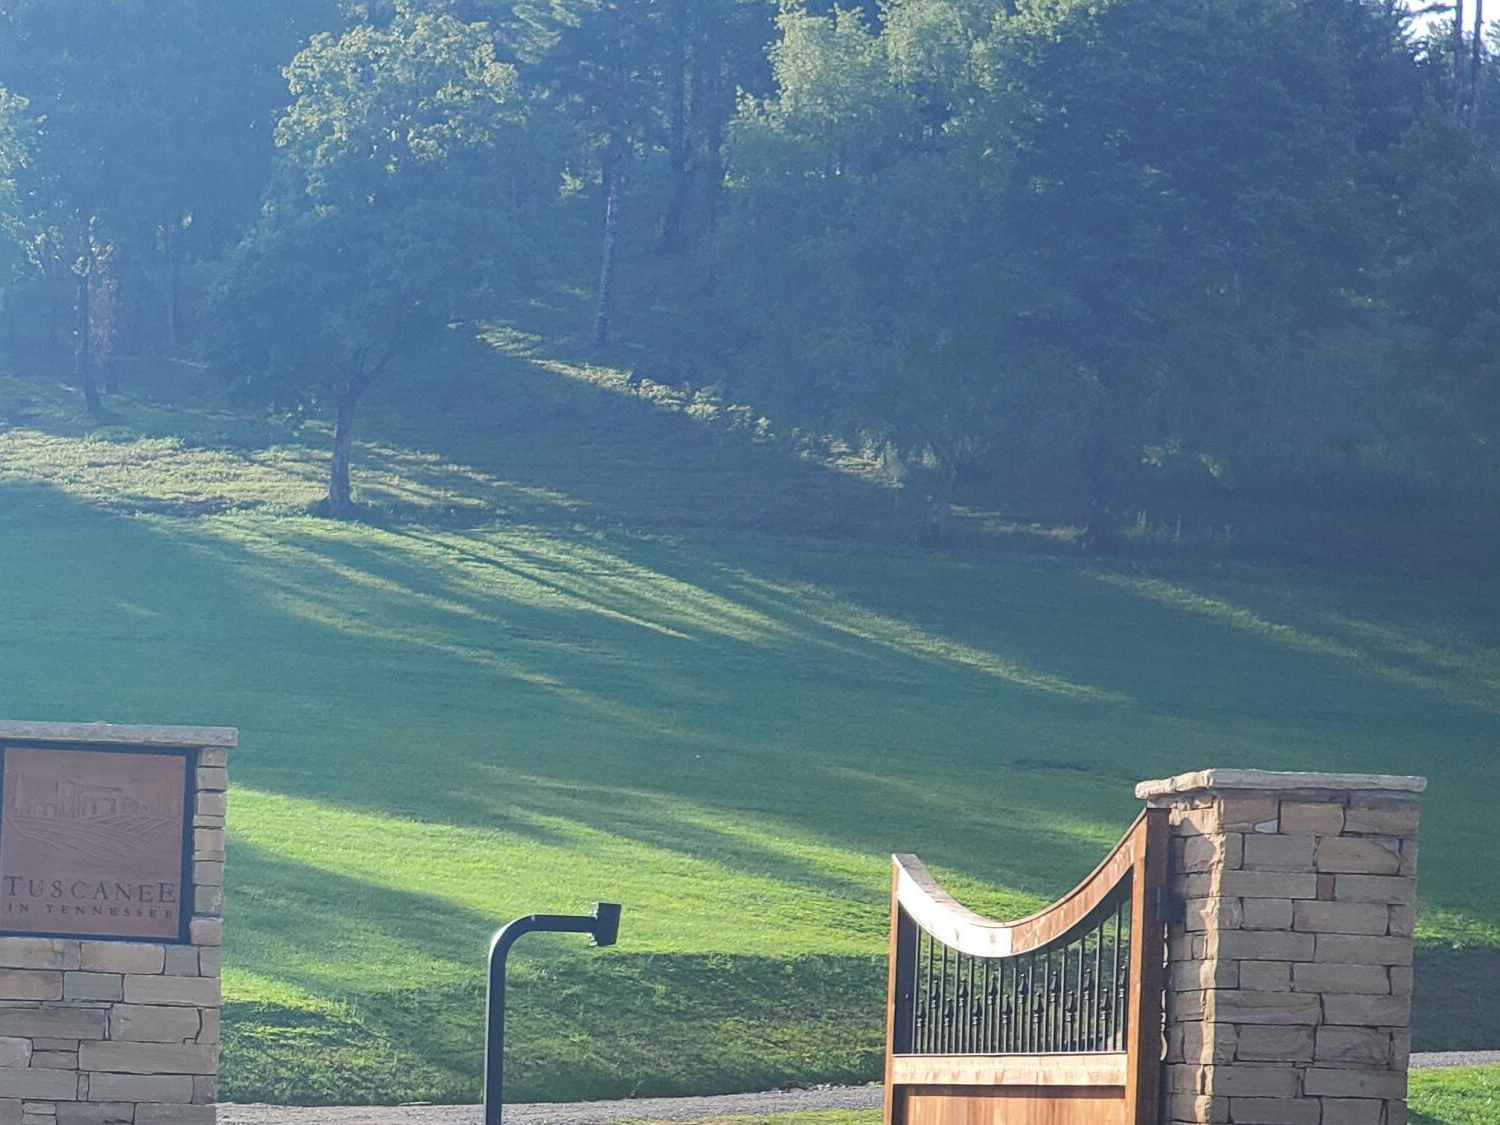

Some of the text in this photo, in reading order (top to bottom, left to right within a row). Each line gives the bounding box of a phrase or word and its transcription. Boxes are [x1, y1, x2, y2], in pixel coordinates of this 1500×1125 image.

[4, 875, 177, 903] TUSCANEE
[8, 903, 173, 919] IN TENNESSEE
